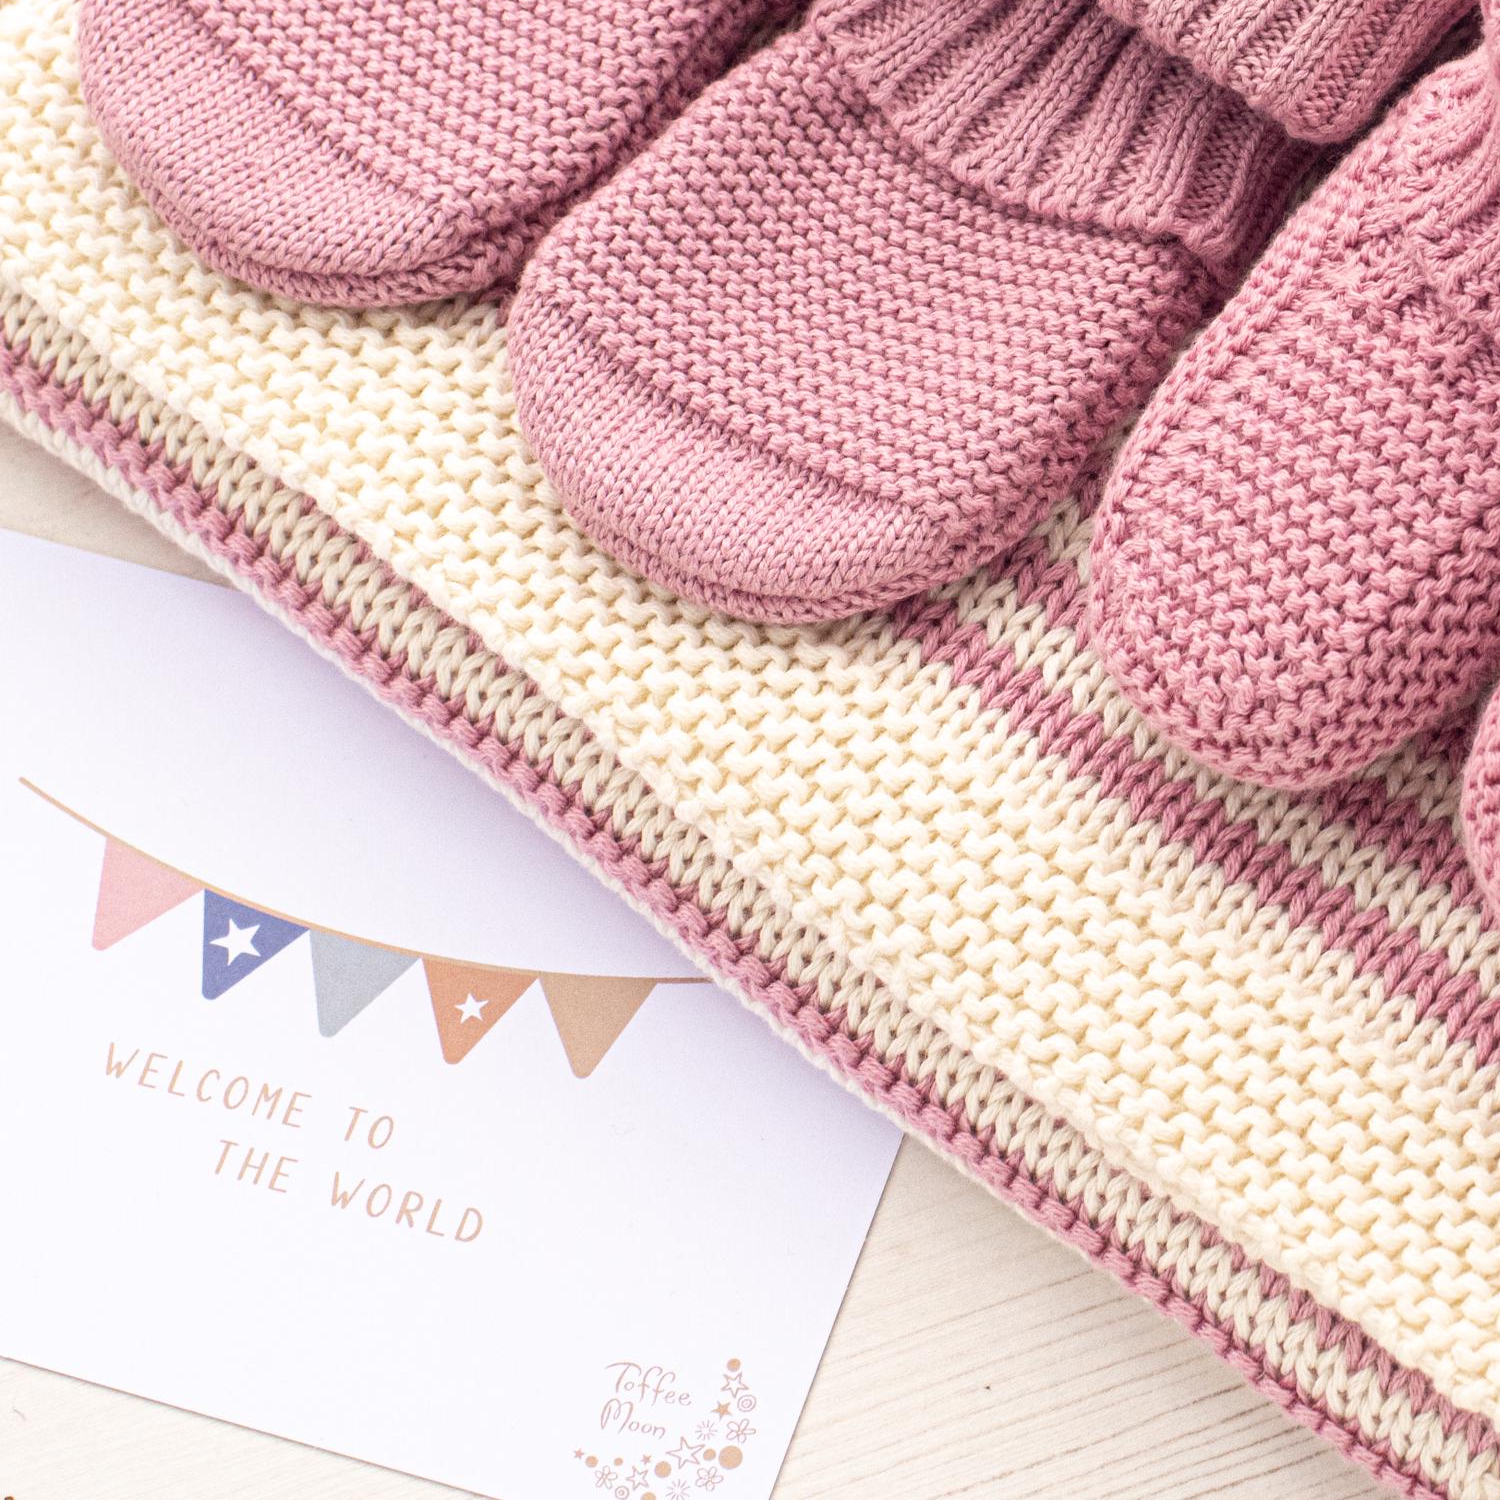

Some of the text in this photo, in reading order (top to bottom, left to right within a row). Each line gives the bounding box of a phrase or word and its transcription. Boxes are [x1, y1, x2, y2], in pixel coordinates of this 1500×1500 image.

[105, 1041, 395, 1149] WELCOME TO
[214, 1140, 483, 1242] THE WORLD
[600, 1398, 667, 1440] Moon
[604, 1361, 692, 1406] Toffee
